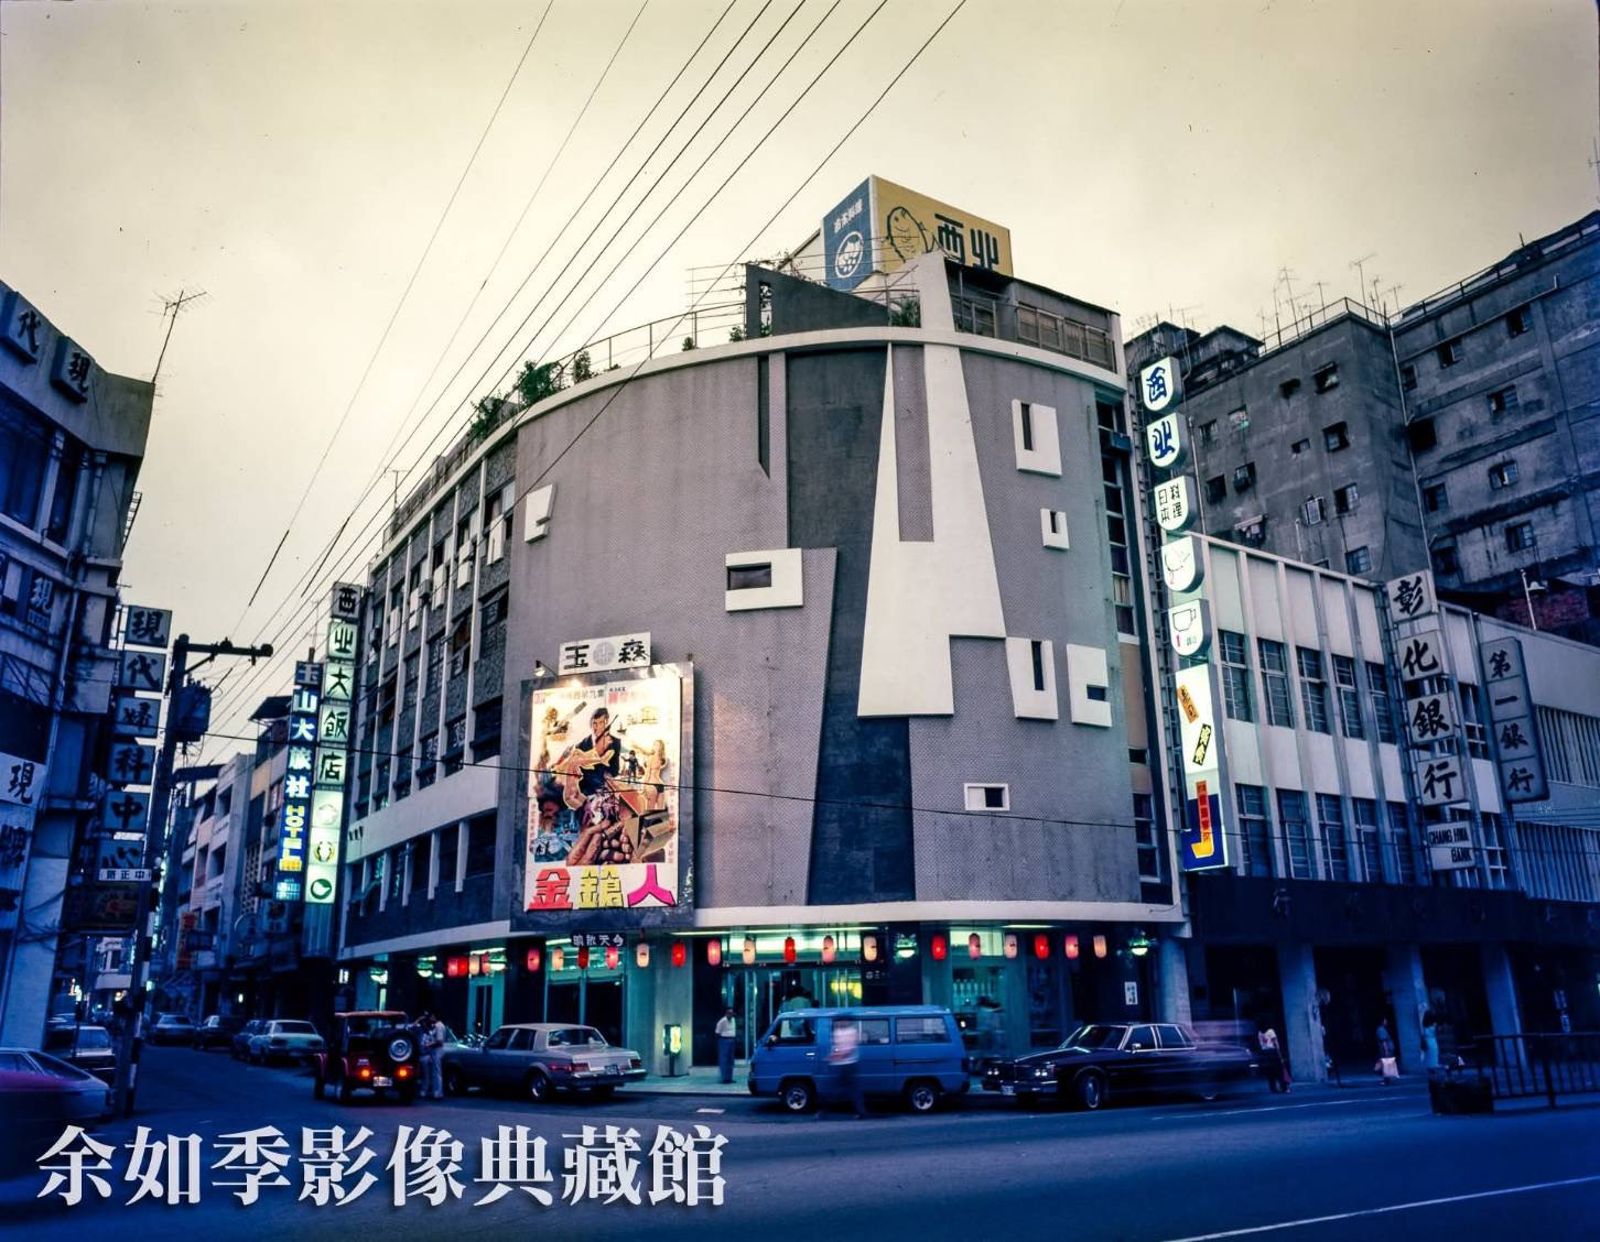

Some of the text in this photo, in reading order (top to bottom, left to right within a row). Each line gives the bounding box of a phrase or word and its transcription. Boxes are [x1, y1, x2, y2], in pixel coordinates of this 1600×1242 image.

[1393, 575, 1457, 800] 彰化銀行
[1489, 650, 1535, 794] 第一銀行
[282, 805, 305, 859] HOTEL
[1451, 847, 1472, 862] BANK
